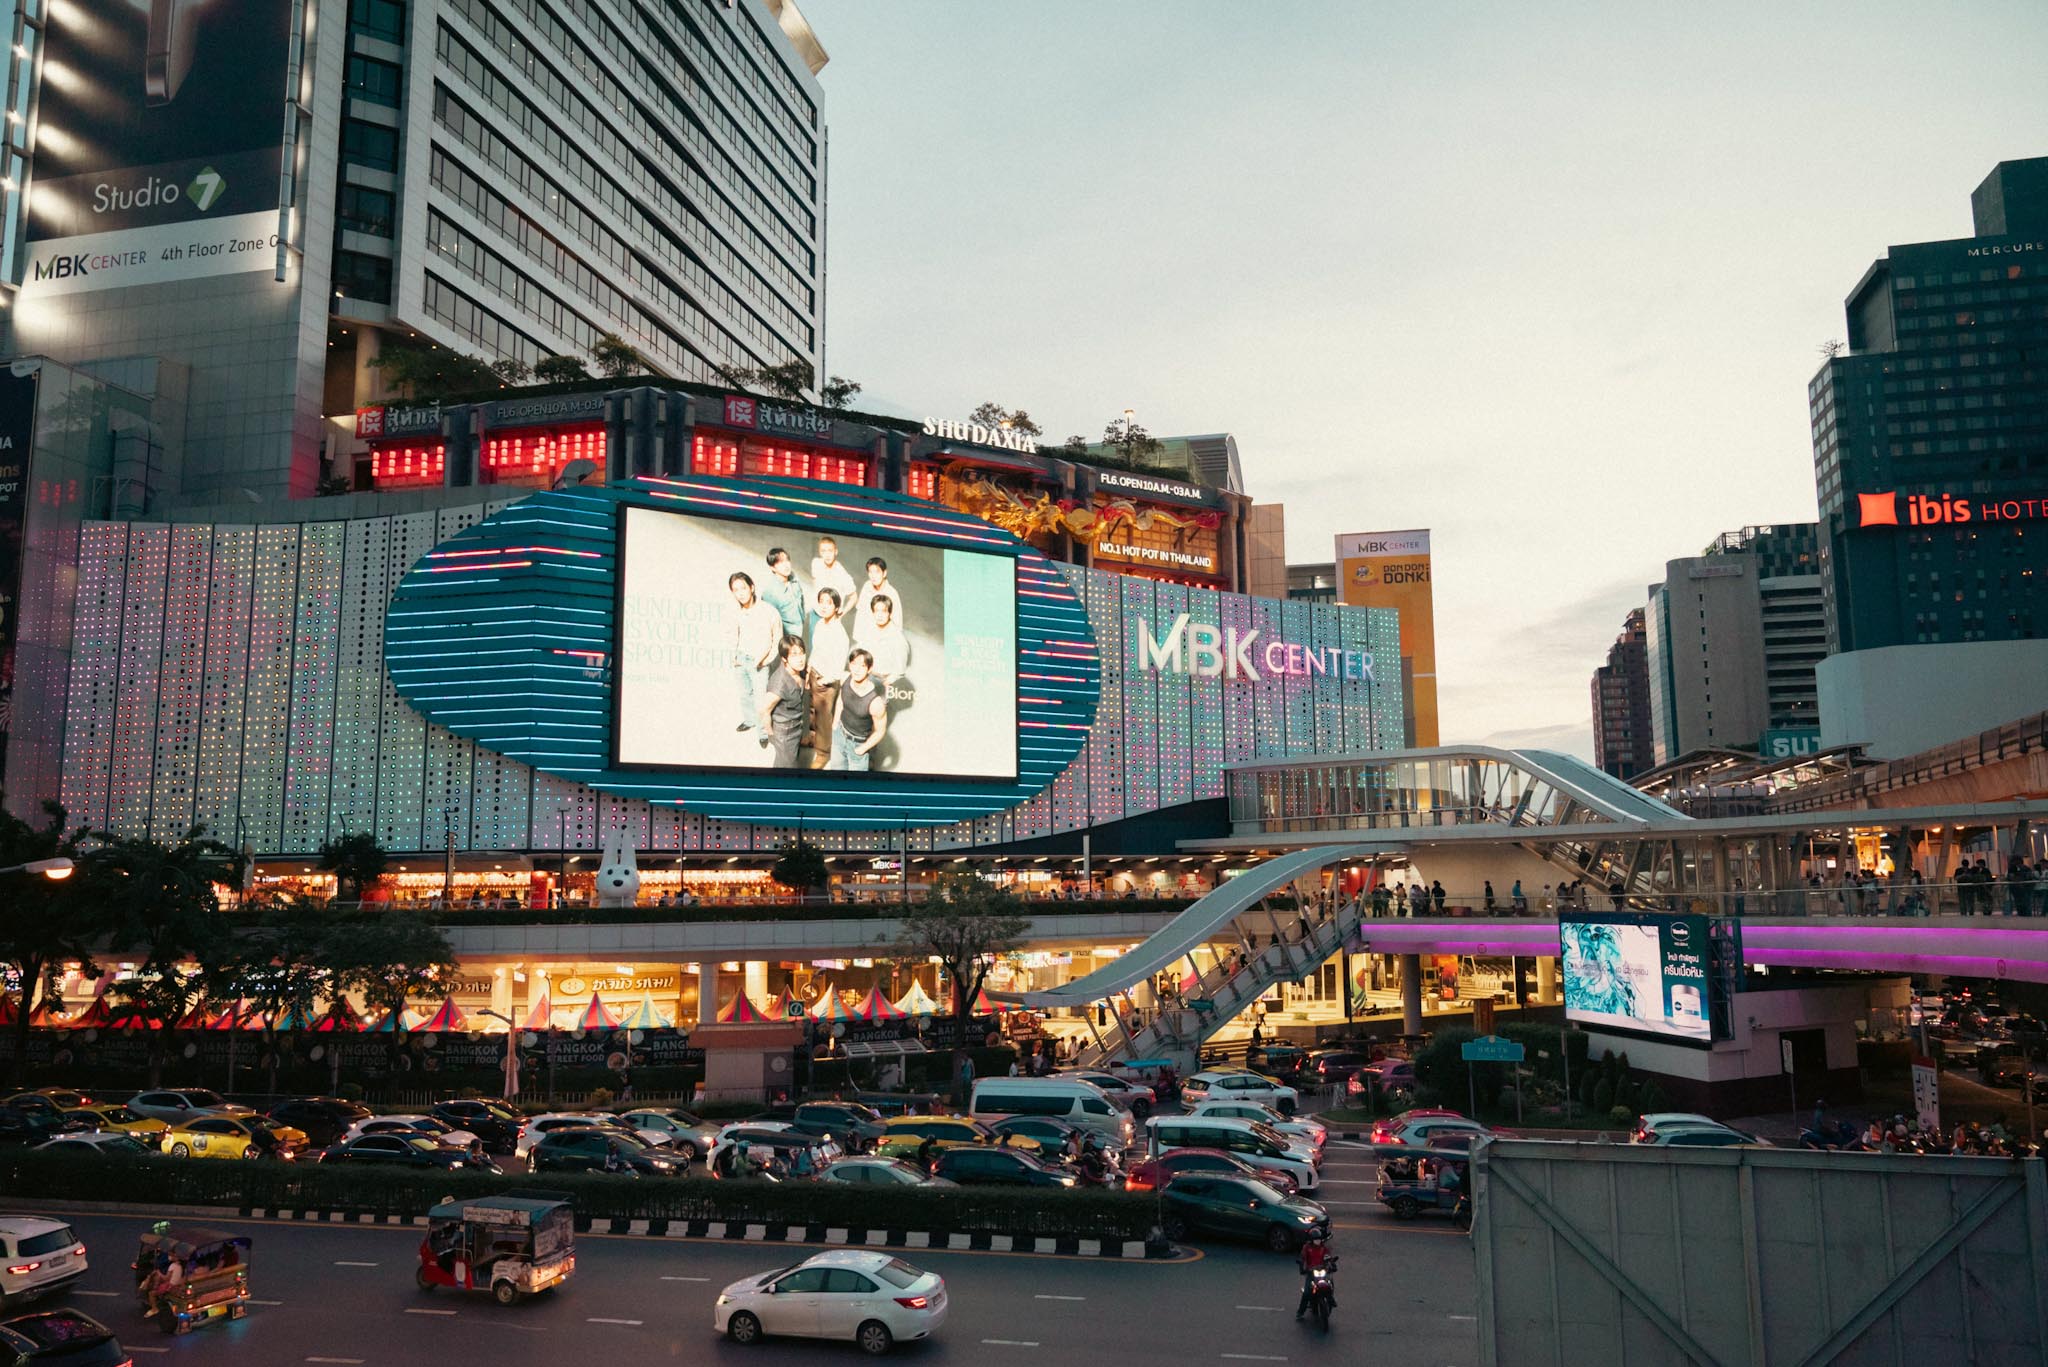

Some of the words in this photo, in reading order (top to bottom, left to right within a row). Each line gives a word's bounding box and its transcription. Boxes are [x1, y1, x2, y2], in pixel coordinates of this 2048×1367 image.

[92, 177, 179, 214] Studio
[195, 172, 222, 212] 7
[34, 252, 91, 282] MBK
[91, 250, 147, 271] CENTER
[161, 245, 183, 262] 4th
[188, 242, 225, 259] Floor
[229, 238, 264, 255] Zone
[1967, 243, 2045, 257] MERCURE
[1908, 493, 1972, 525] ibis
[1100, 542, 1121, 555] NO.1
[1122, 545, 1141, 557] HOT
[1142, 548, 1159, 560] POT
[1160, 551, 1169, 561] IN
[1170, 552, 1212, 568] THAILAND
[1358, 541, 1388, 553] MBK
[1389, 541, 1421, 551] CENTER
[624, 593, 729, 624] SUNLIGHT
[645, 621, 699, 644] YOUR
[1138, 613, 1261, 682] MBK
[1264, 640, 1375, 682] CENTER
[872, 861, 890, 869] MBK
[446, 1044, 499, 1056] BANGKOK
[580, 1053, 605, 1062] FOOD
